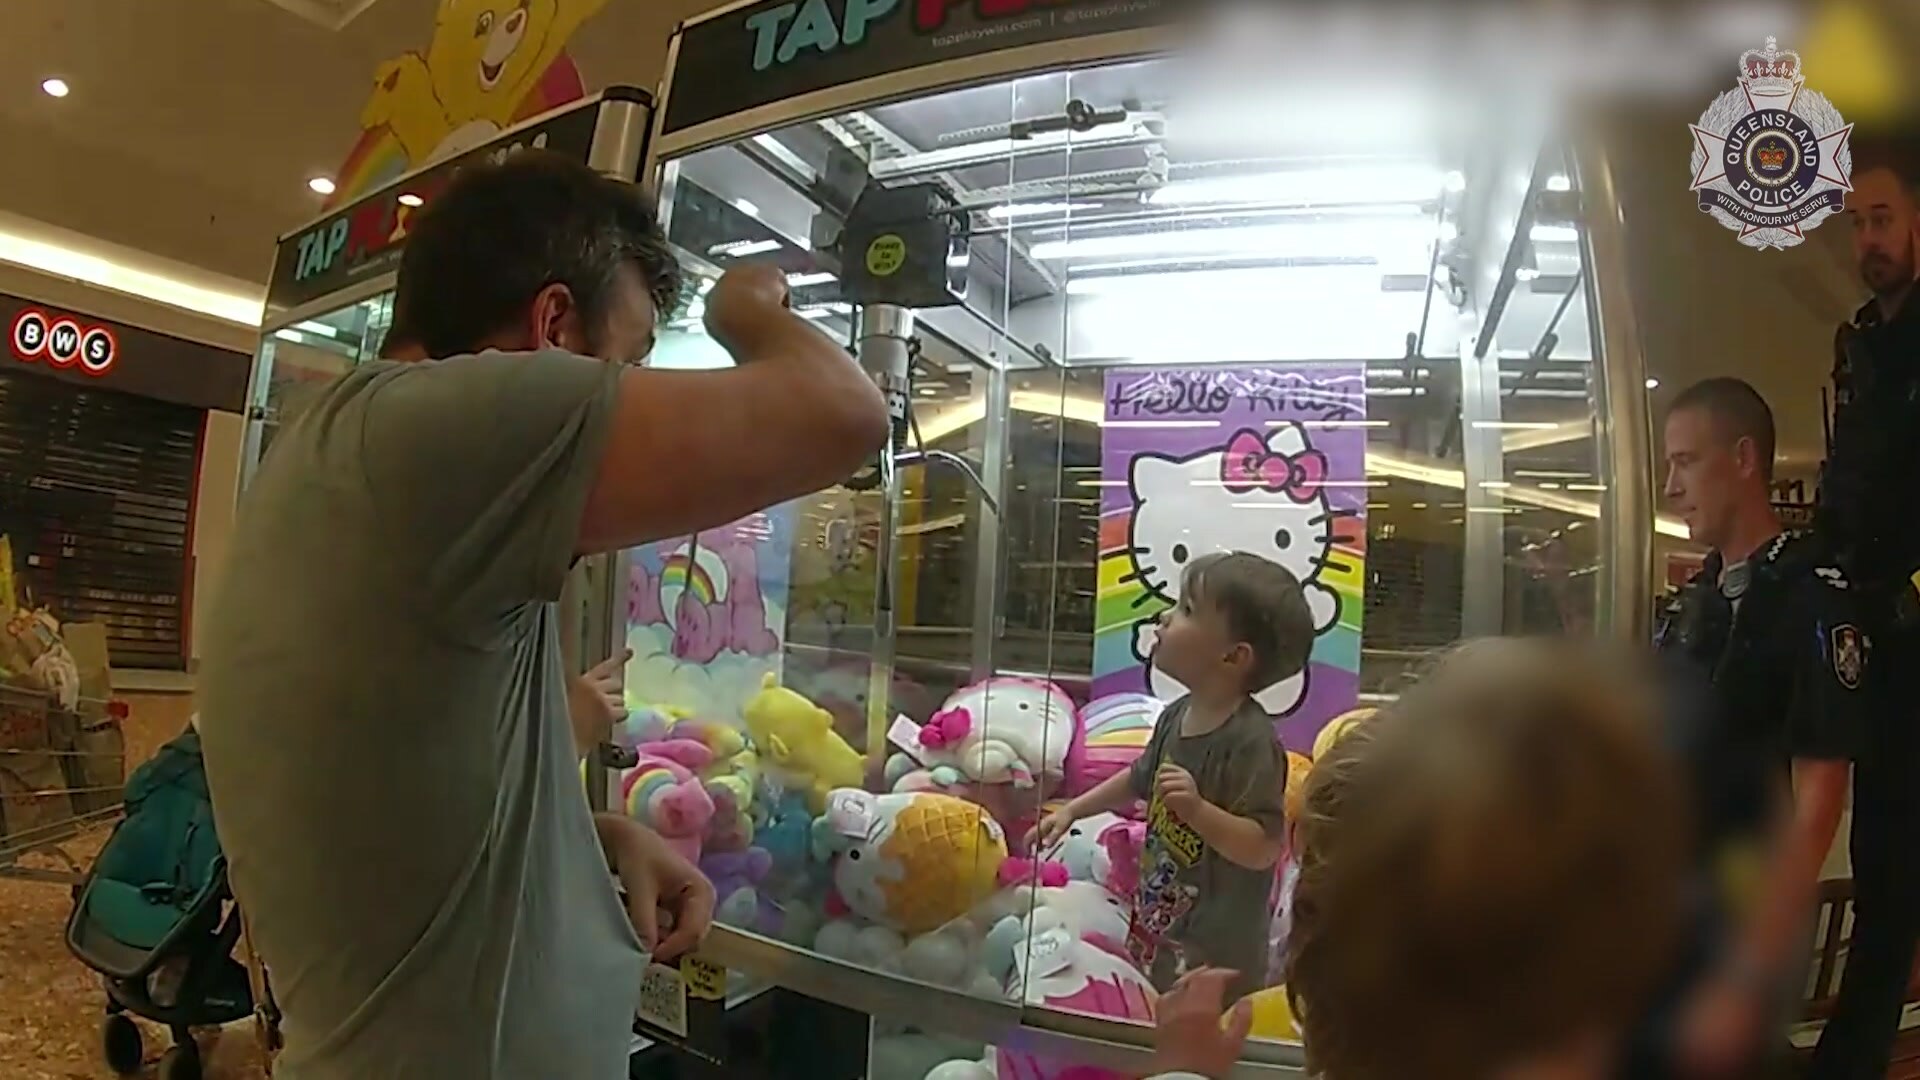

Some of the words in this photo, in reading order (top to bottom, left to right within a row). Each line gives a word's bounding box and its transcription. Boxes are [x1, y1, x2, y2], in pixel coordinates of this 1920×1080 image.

[745, 0, 896, 71] TAP
[295, 218, 348, 281] TAP
[24, 322, 106, 360] BWS
[1110, 379, 1232, 416] Hello
